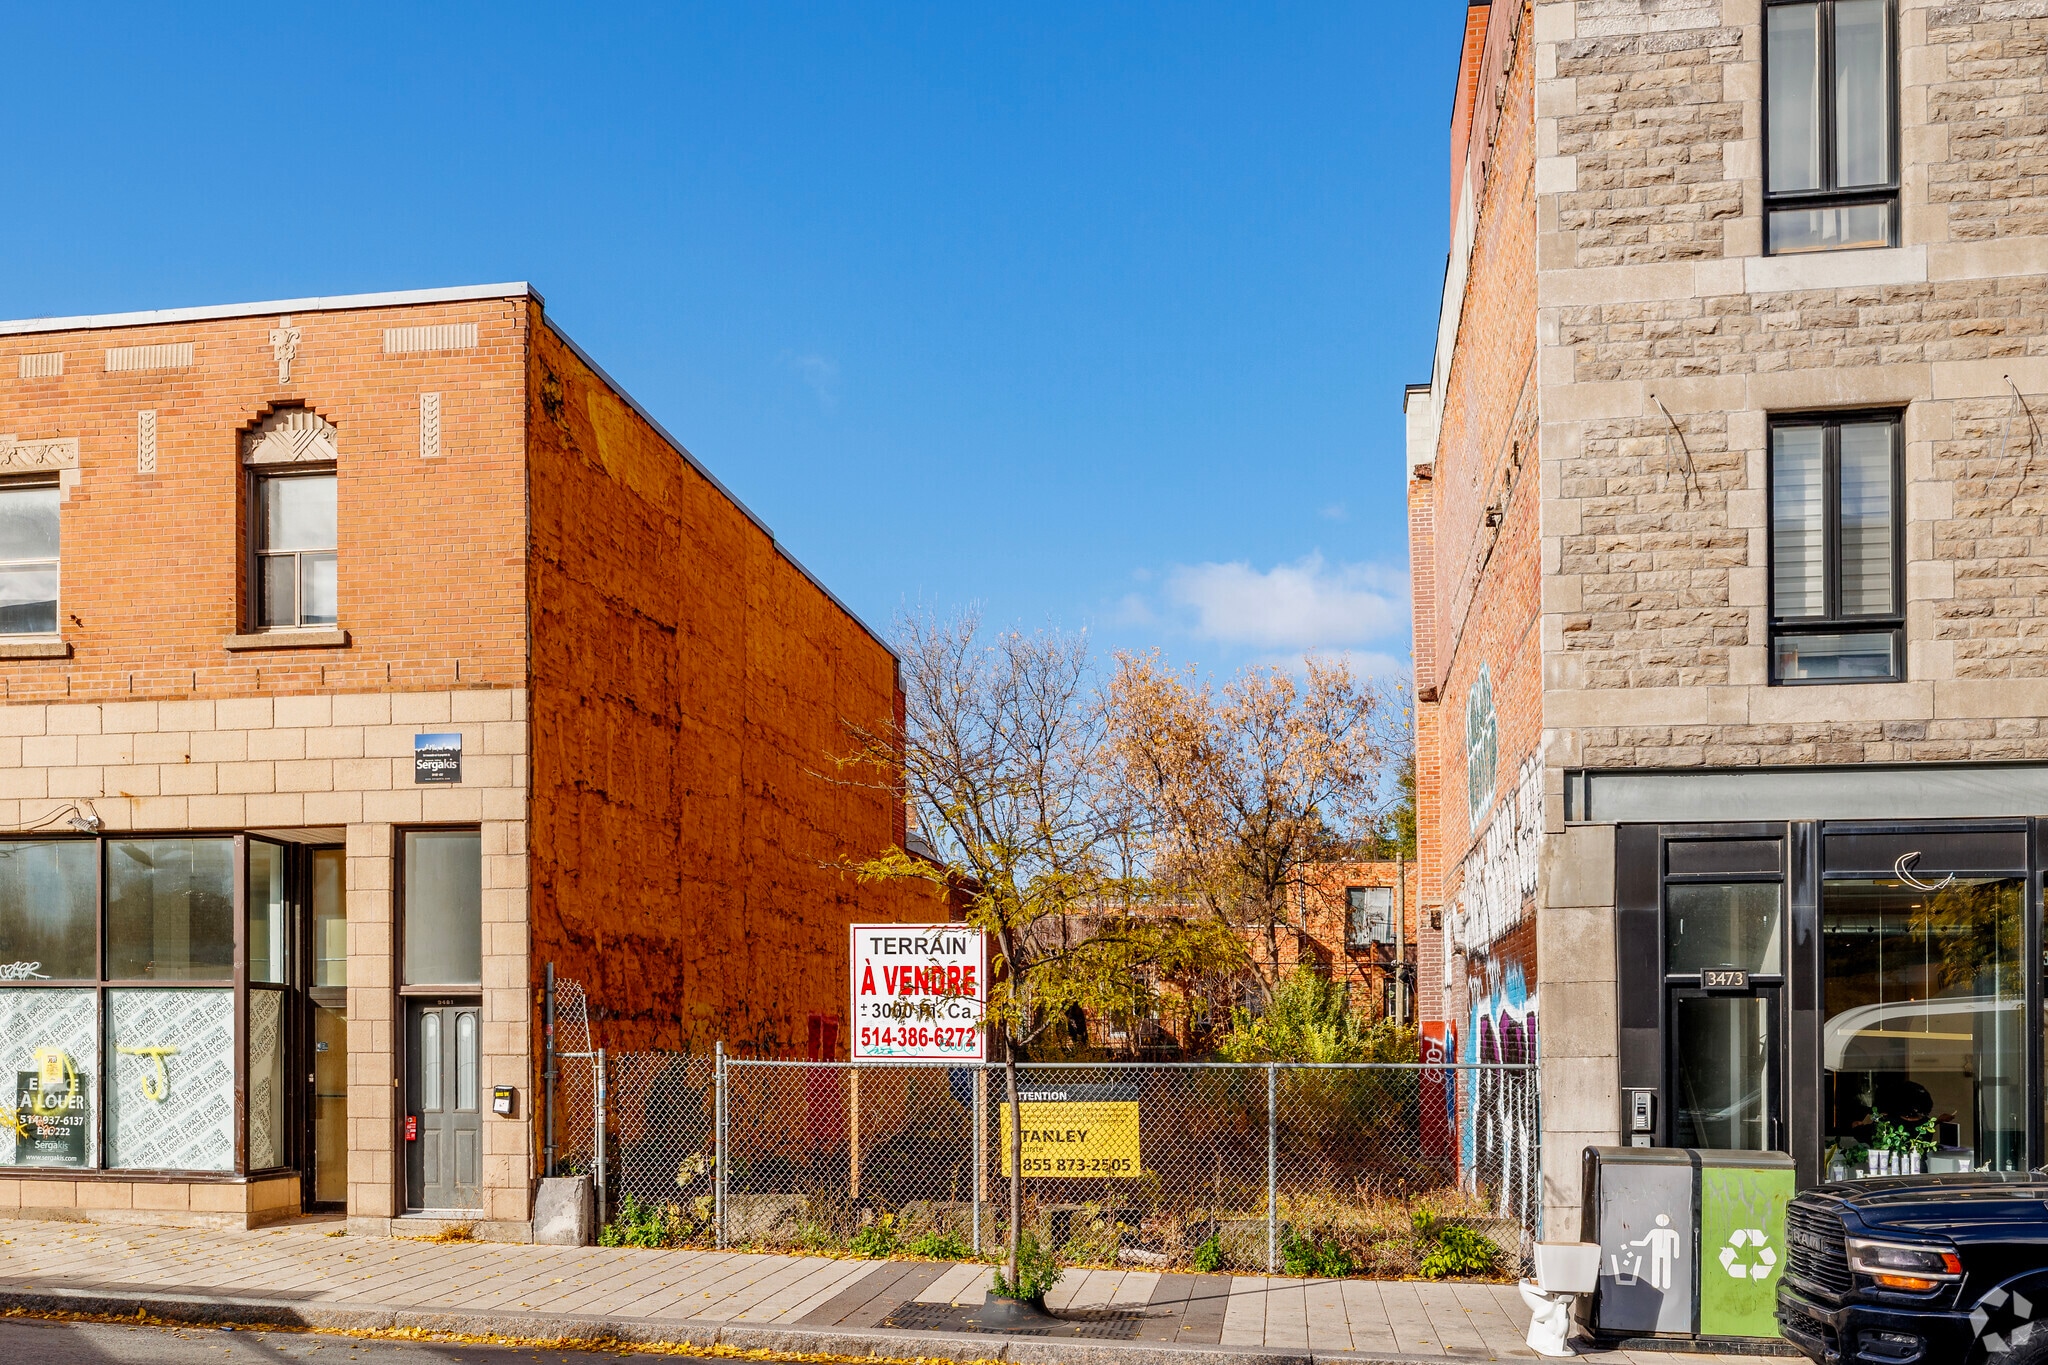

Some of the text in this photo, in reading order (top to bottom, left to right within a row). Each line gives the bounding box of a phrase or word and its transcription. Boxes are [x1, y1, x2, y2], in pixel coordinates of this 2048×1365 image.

[416, 758, 458, 772] Sergakis
[870, 937, 966, 955] TERRAIN
[861, 958, 976, 996] À VENDRE
[1708, 972, 1743, 986] 3473
[872, 1003, 913, 1018] 3000
[861, 1027, 976, 1047] 514-386-6272
[20, 1091, 84, 1110] À LOUER
[1017, 1092, 1067, 1100] TTENTION
[1011, 1130, 1088, 1142] TANLEY
[35, 1140, 68, 1150] Sergakis
[1023, 1158, 1130, 1171] 855 873-2505
[1793, 1230, 1820, 1251] RAM
